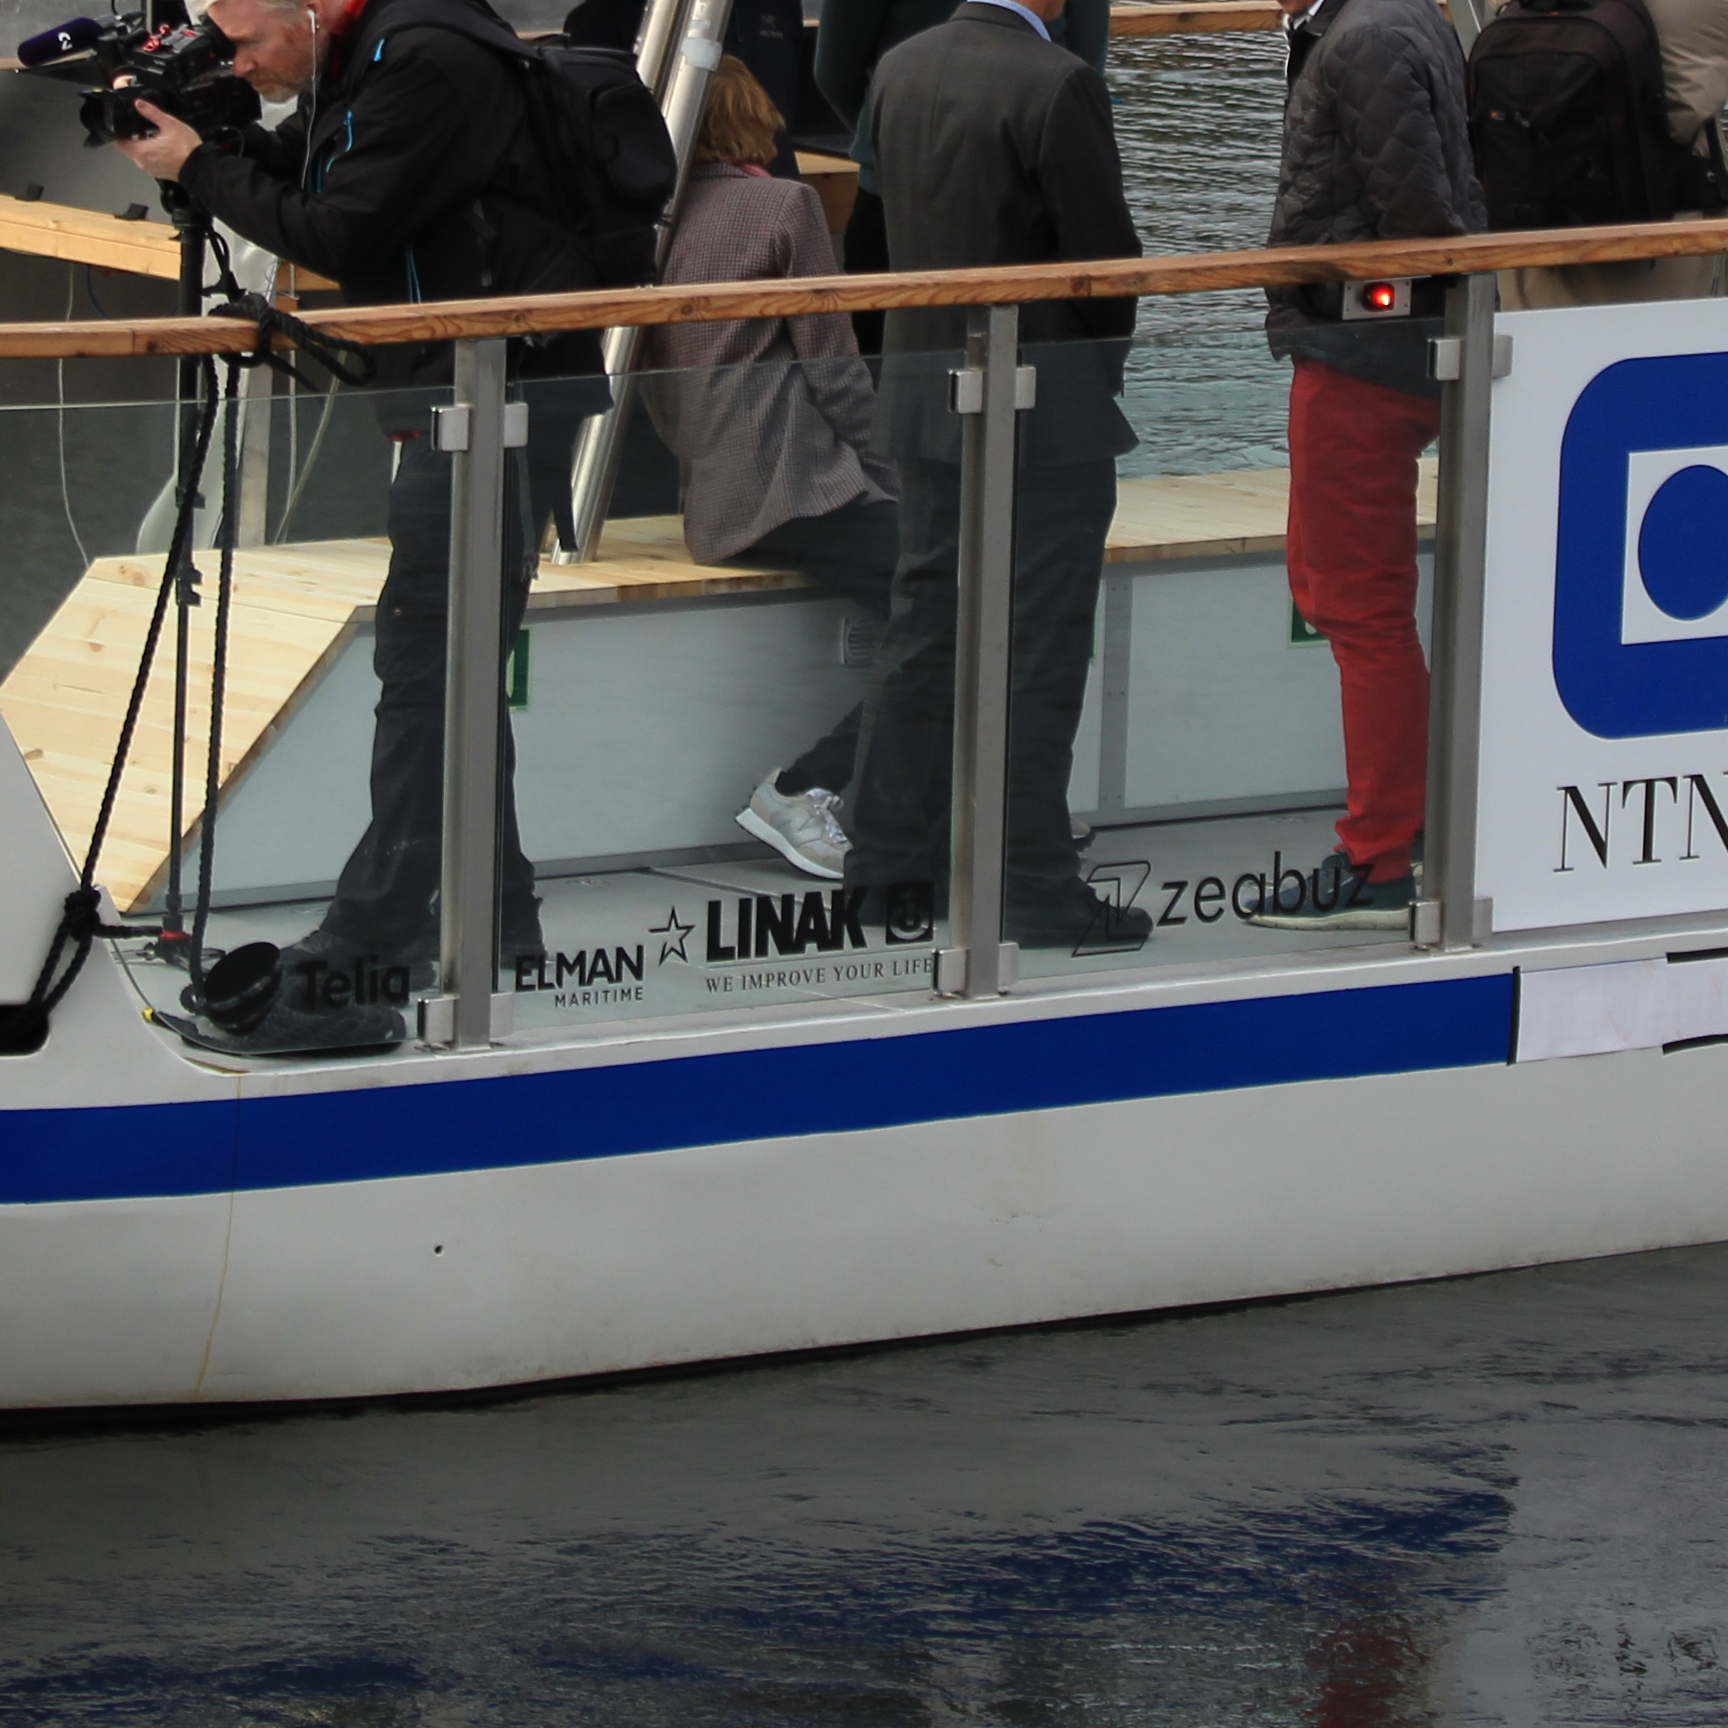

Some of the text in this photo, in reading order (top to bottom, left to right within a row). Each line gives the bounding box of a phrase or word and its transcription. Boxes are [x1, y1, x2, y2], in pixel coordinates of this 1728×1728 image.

[1156, 850, 1376, 927] zeabuz
[706, 886, 870, 962] LINAK
[295, 954, 411, 1011] Telia
[515, 944, 645, 992] ELMAN
[706, 957, 934, 994] WE IMPROVE YOUR LIFE
[554, 986, 645, 1009] MARITIME
